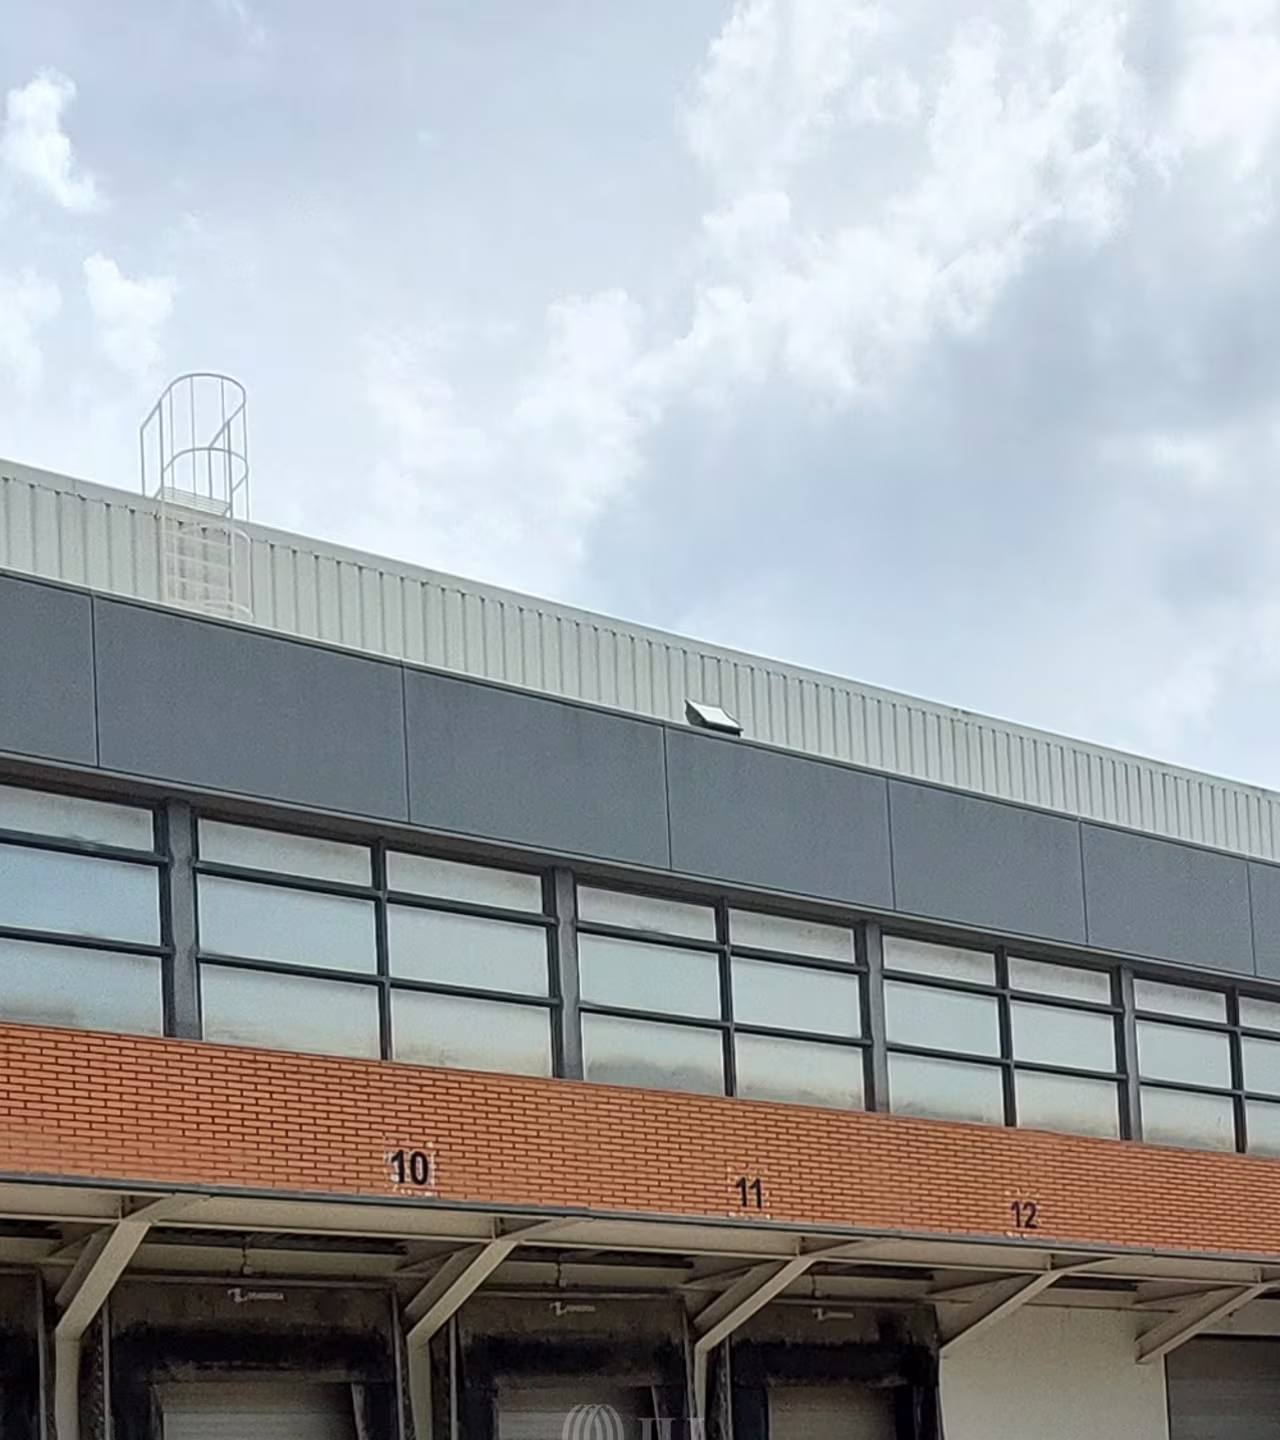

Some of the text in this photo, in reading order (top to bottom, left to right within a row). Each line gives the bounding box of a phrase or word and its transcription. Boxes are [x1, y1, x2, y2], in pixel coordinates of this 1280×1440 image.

[391, 1150, 429, 1185] 10
[735, 1176, 762, 1209] 11
[1010, 1200, 1038, 1229] 12
